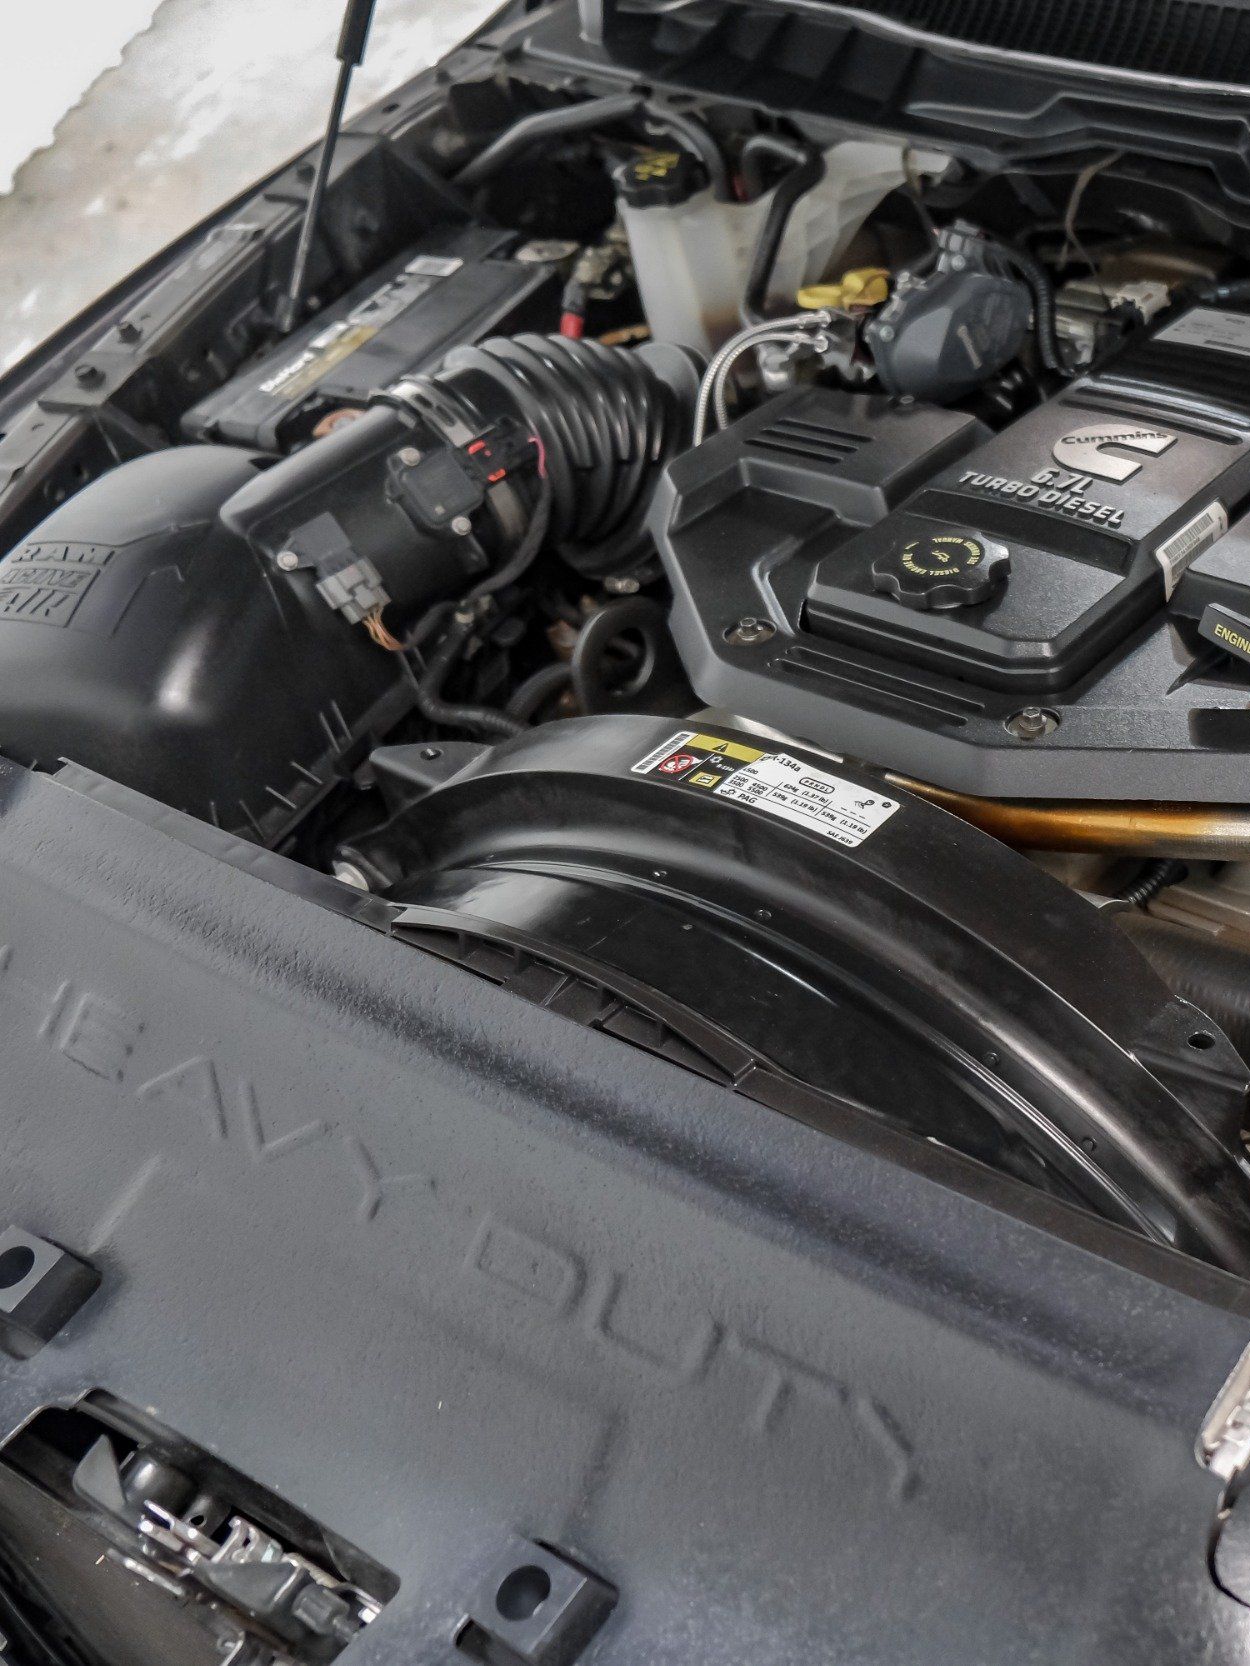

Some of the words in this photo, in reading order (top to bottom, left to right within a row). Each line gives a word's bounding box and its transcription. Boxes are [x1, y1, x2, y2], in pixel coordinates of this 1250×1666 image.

[1060, 428, 1169, 446] Cummins
[1030, 467, 1094, 495] 6.7L
[958, 470, 1040, 499] TURBO
[1041, 488, 1127, 528] DIESEL
[18, 546, 116, 566] RAM
[738, 793, 757, 804] PAG
[462, 1207, 922, 1500] DUTY
